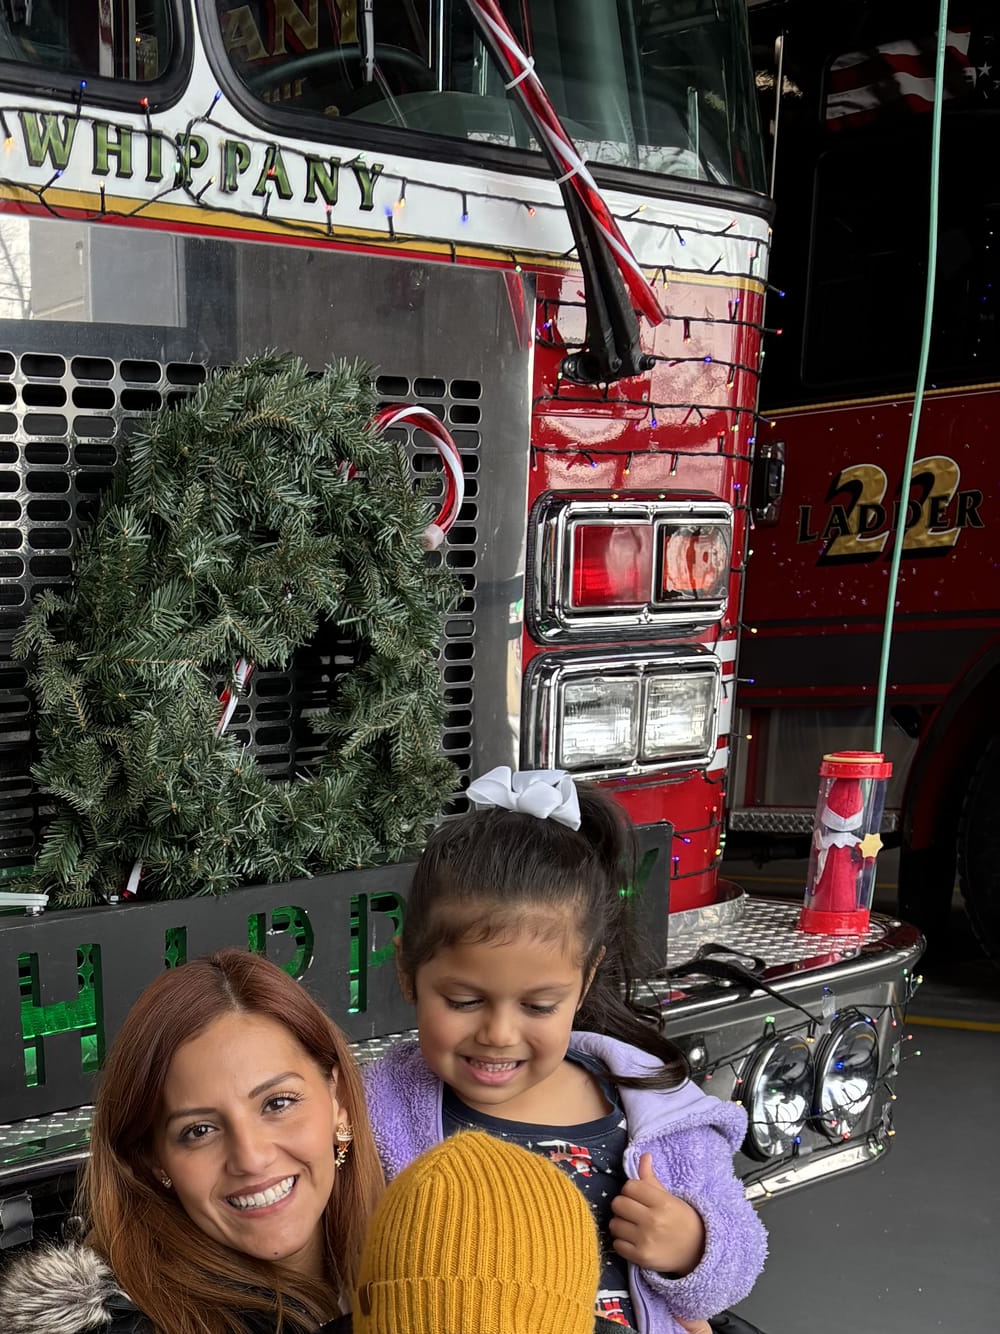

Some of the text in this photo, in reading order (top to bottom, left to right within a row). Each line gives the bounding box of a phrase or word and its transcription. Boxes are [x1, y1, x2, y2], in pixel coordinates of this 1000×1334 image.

[18, 110, 385, 211] WHIPPANY
[797, 489, 985, 544] LADDER
[816, 455, 961, 566] 22
